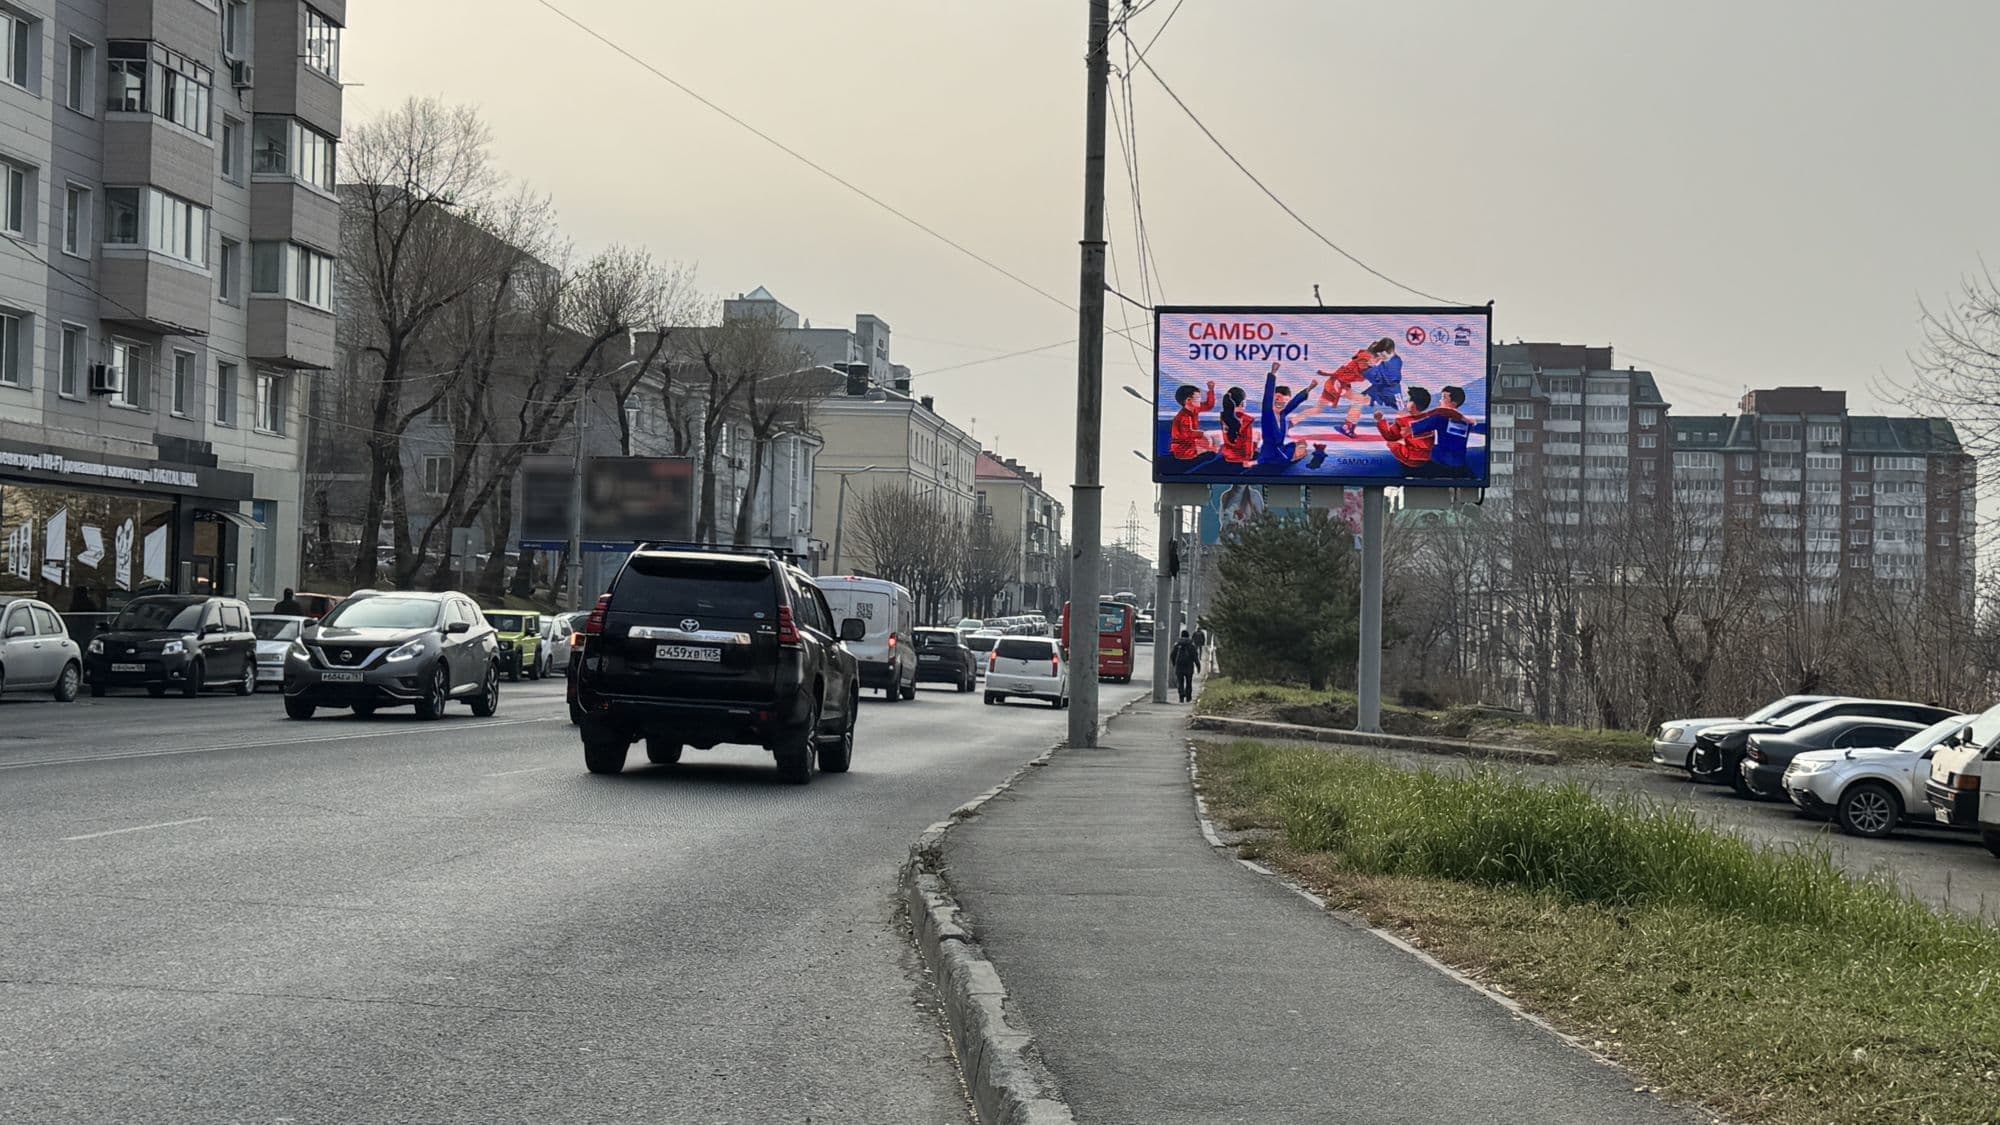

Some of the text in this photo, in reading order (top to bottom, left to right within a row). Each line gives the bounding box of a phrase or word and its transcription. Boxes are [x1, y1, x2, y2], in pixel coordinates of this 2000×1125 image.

[1189, 323, 1274, 340] САМБО
[1189, 344, 1308, 360] ЭТО КРУТО!
